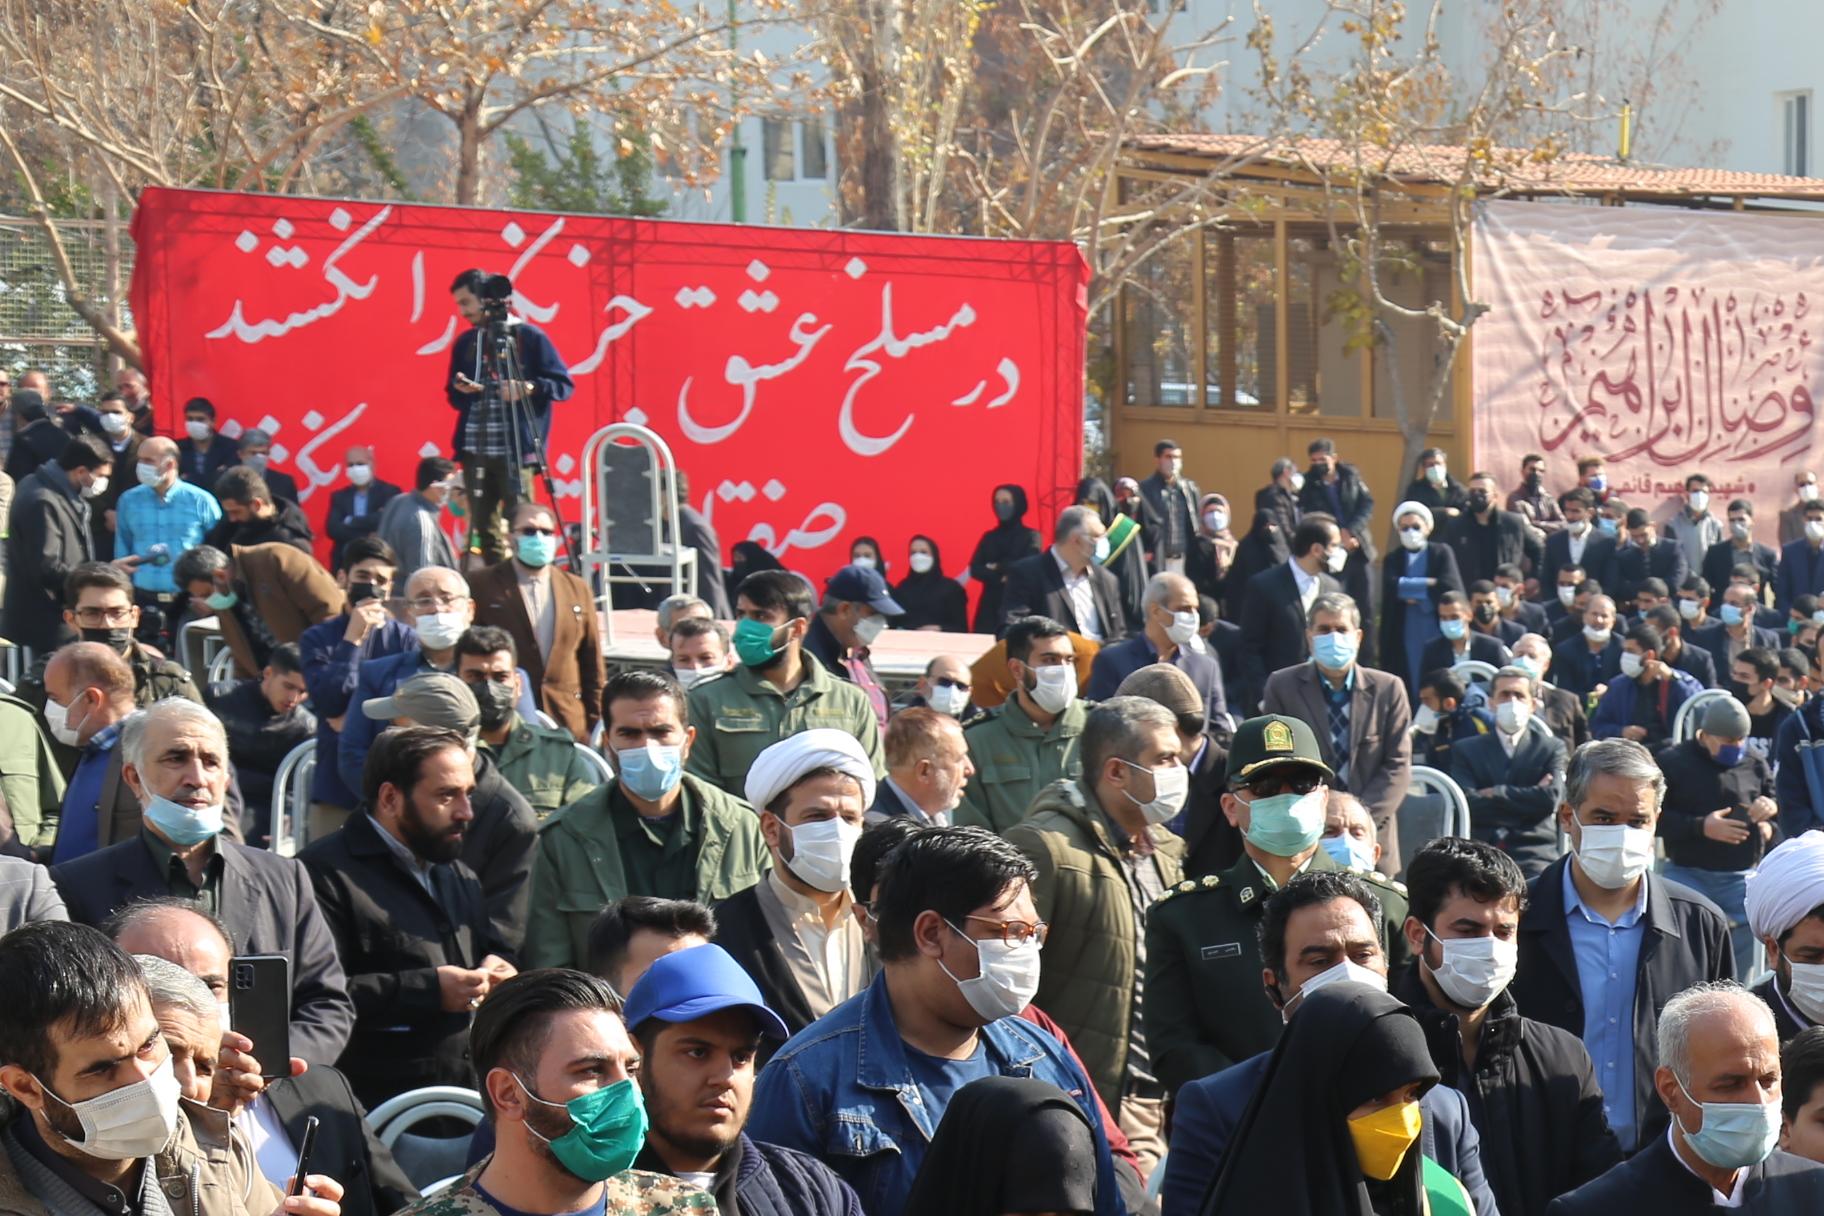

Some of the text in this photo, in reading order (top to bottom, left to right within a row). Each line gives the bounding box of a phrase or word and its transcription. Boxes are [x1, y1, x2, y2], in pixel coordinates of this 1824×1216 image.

[204, 204, 393, 344] نکشند
[675, 259, 832, 444] عشق
[838, 257, 976, 456] مسلخ
[953, 357, 1020, 408] در
